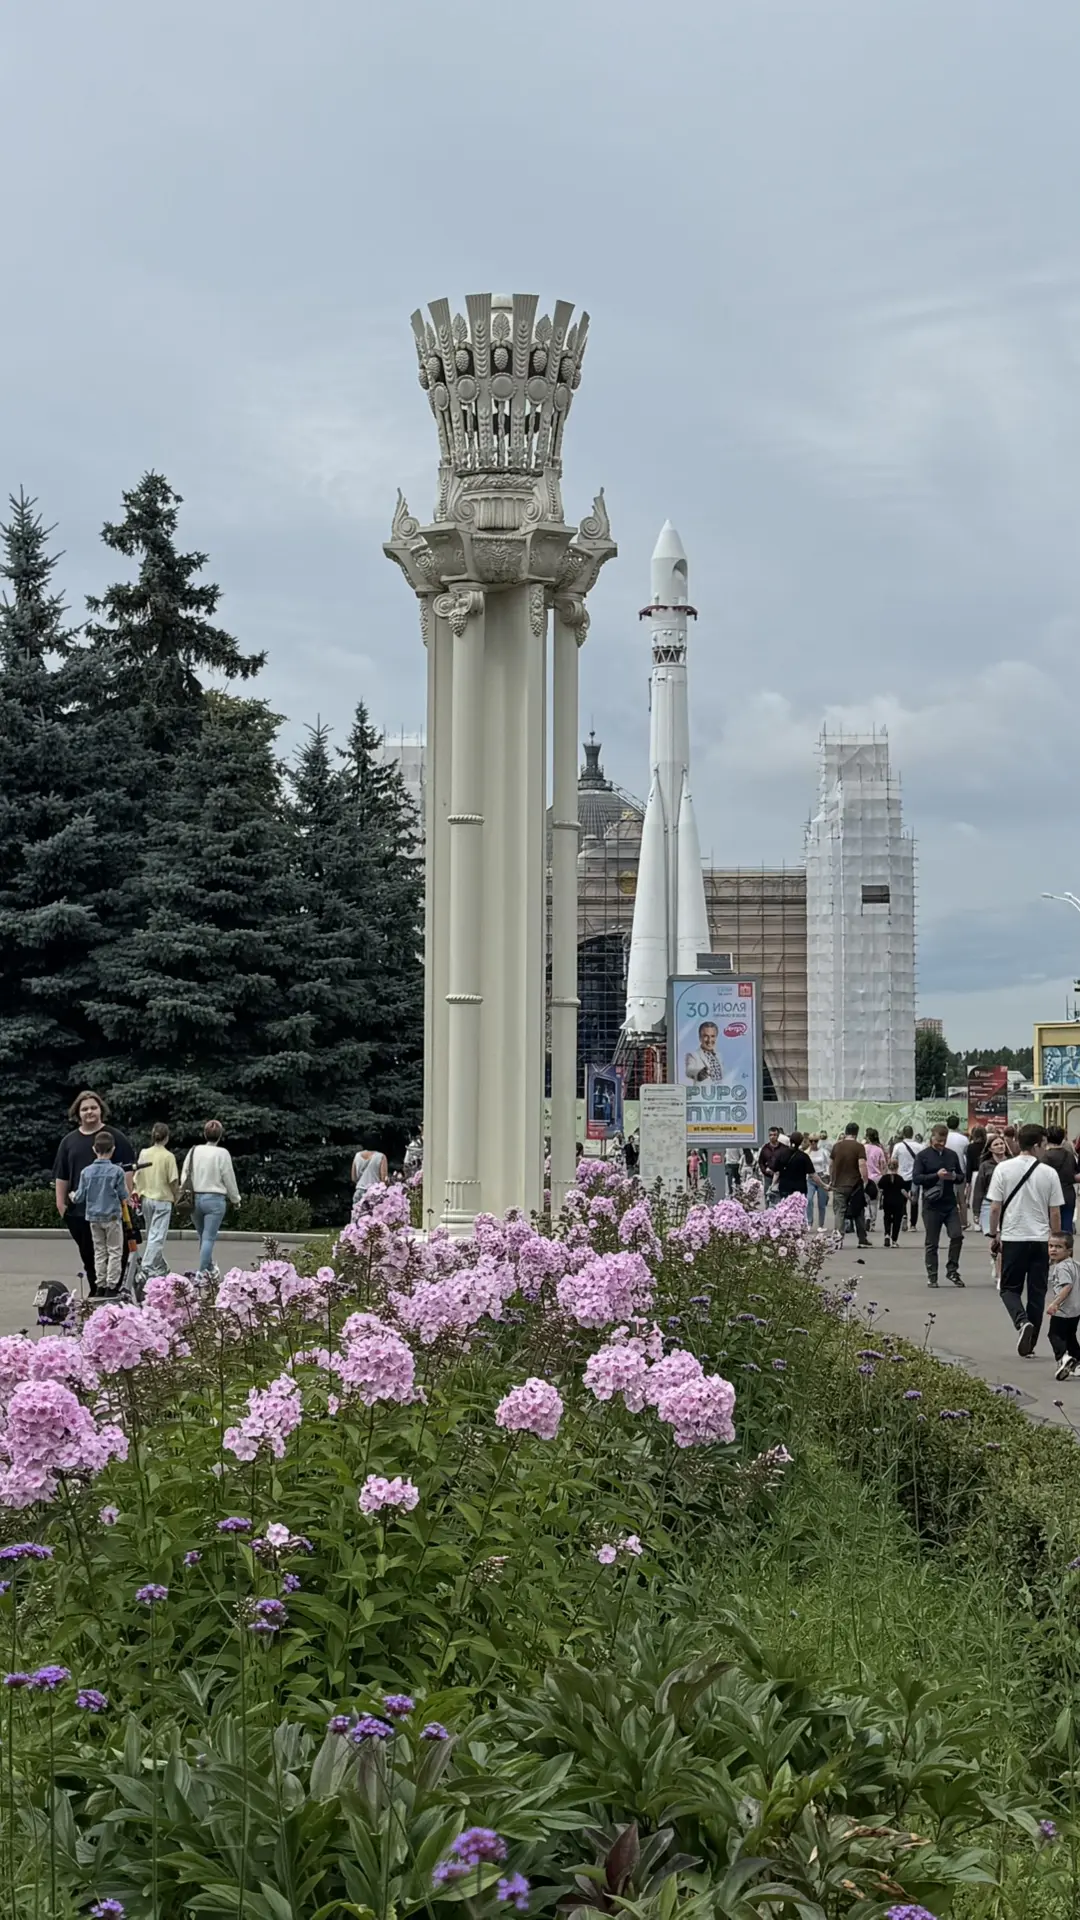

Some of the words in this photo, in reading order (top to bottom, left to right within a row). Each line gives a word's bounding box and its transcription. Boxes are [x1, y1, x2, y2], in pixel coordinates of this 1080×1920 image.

[686, 1002, 709, 1018] 30
[712, 1002, 746, 1012] ИЮЛЯ
[686, 1085, 747, 1101] PUPO
[686, 1106, 747, 1122] ПУПО
